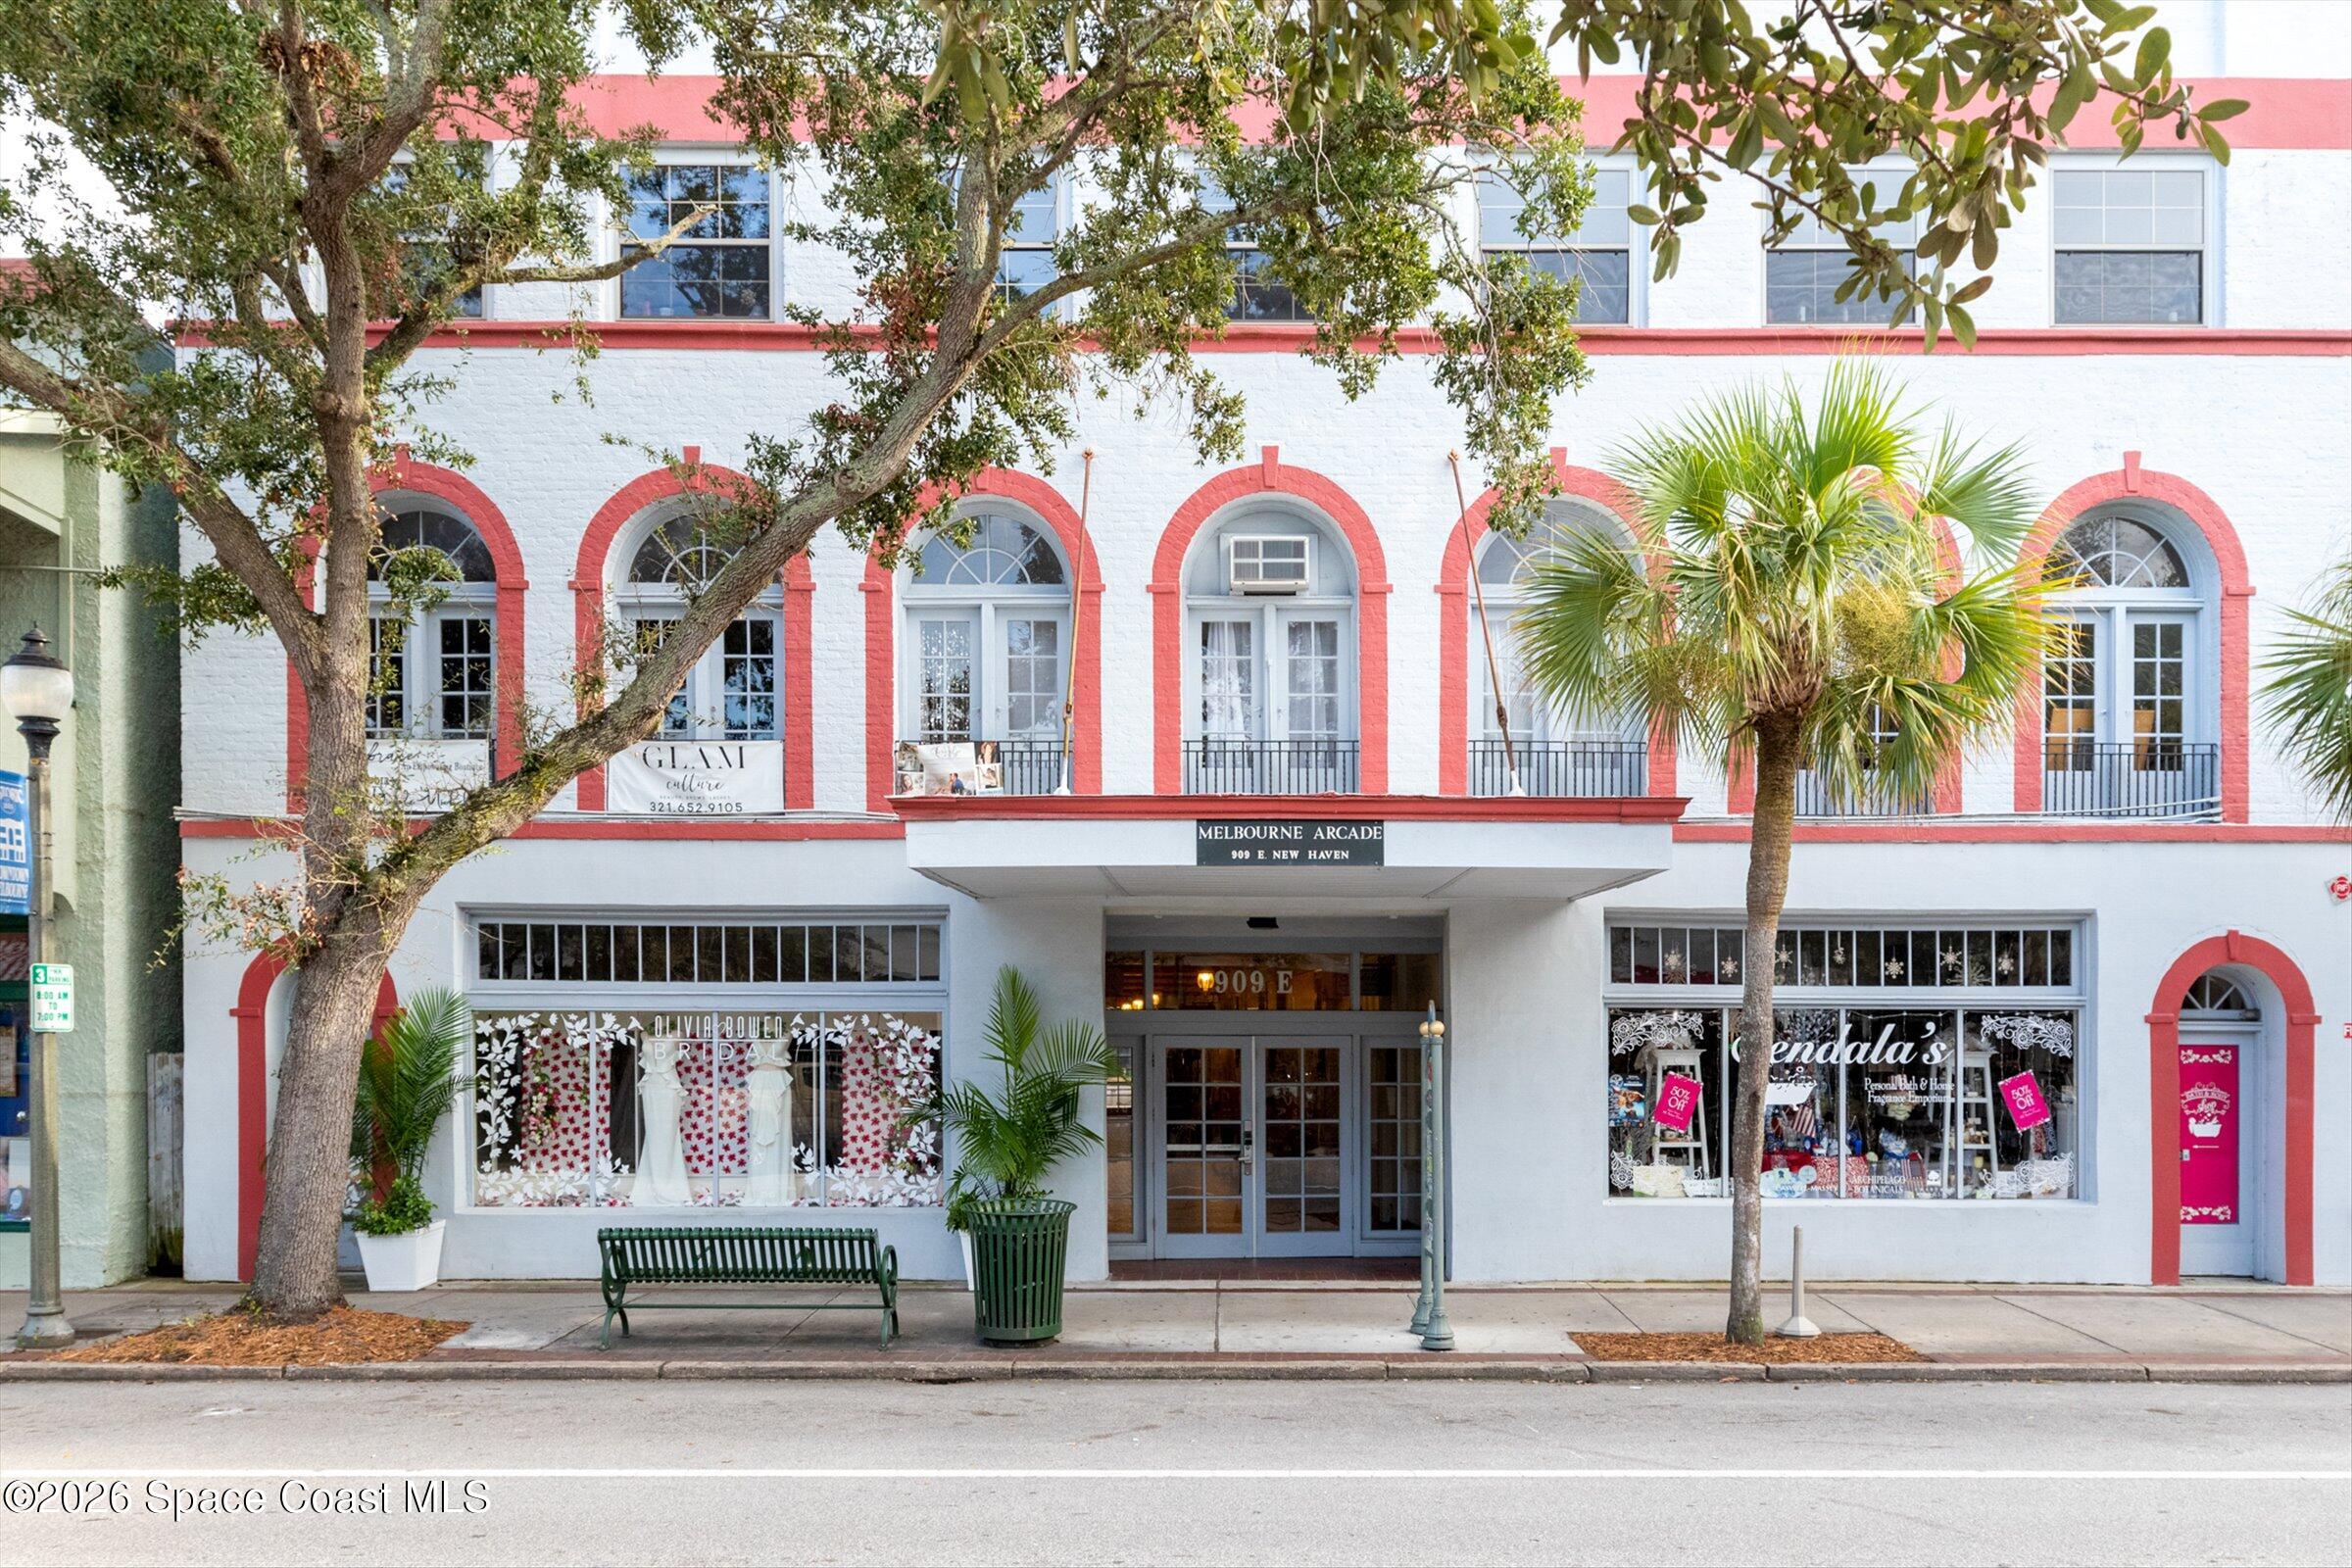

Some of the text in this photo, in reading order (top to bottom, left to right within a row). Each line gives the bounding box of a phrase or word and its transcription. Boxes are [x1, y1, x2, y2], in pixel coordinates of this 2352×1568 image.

[642, 745, 745, 769] GLAM
[665, 772, 725, 793] culture
[650, 802, 743, 813] 321.652.9105
[1198, 825, 1383, 840] MELBOURNE ARCADE
[1231, 850, 1250, 859] 909
[1272, 850, 1299, 859] NEW
[1307, 850, 1349, 859] HAVEN
[35, 968, 45, 983] 3
[1215, 970, 1293, 994] 909 E
[58, 991, 69, 1000] AM
[49, 1002, 58, 1010] TO
[57, 1012, 69, 1021] PM
[655, 1015, 782, 1039] OLIVIA BOWEN
[1732, 1021, 1955, 1065] endala's
[655, 1042, 783, 1061] BRIDAL
[1864, 1077, 1897, 1091] Personal
[1920, 1077, 1928, 1091] &
[1930, 1077, 1955, 1091] Home
[1670, 1086, 1691, 1101] 50%
[1867, 1091, 1955, 1105] Fragrance Emporium
[2011, 1085, 2034, 1100] 50%
[1668, 1096, 1689, 1111] Off
[2016, 1095, 2034, 1109] Off
[1852, 1175, 1906, 1184] ARCHIPELAGO
